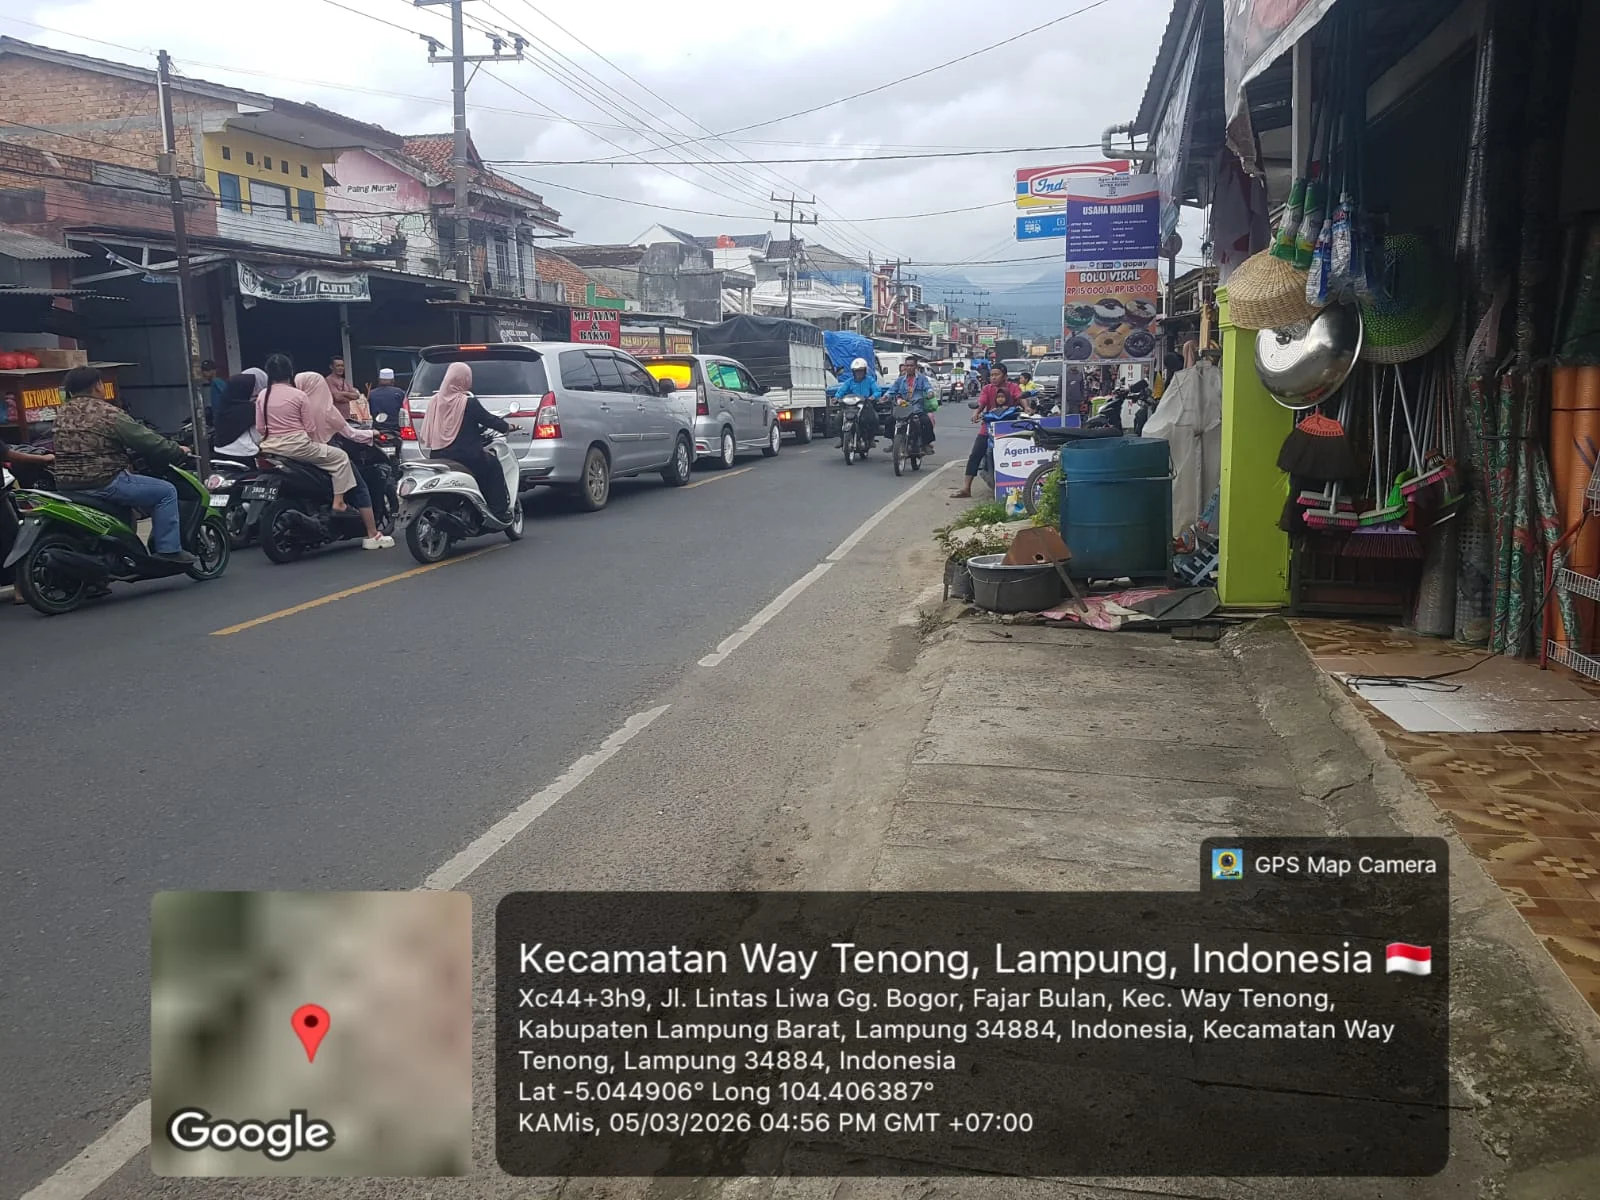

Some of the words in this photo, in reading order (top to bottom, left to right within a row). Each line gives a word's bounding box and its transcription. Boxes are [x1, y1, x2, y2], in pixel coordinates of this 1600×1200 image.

[1035, 178, 1067, 192] Ind
[1082, 206, 1108, 216] USAHA
[1109, 204, 1144, 214] MANDIRI
[1122, 261, 1148, 269] gopay
[1080, 273, 1107, 283] BOLU
[1109, 271, 1141, 281] VIRAL
[572, 311, 591, 321] MIE
[592, 311, 618, 321] AYAM
[591, 321, 599, 330] &
[579, 330, 612, 341] BAKSO
[23, 388, 61, 408] KETOPRAK
